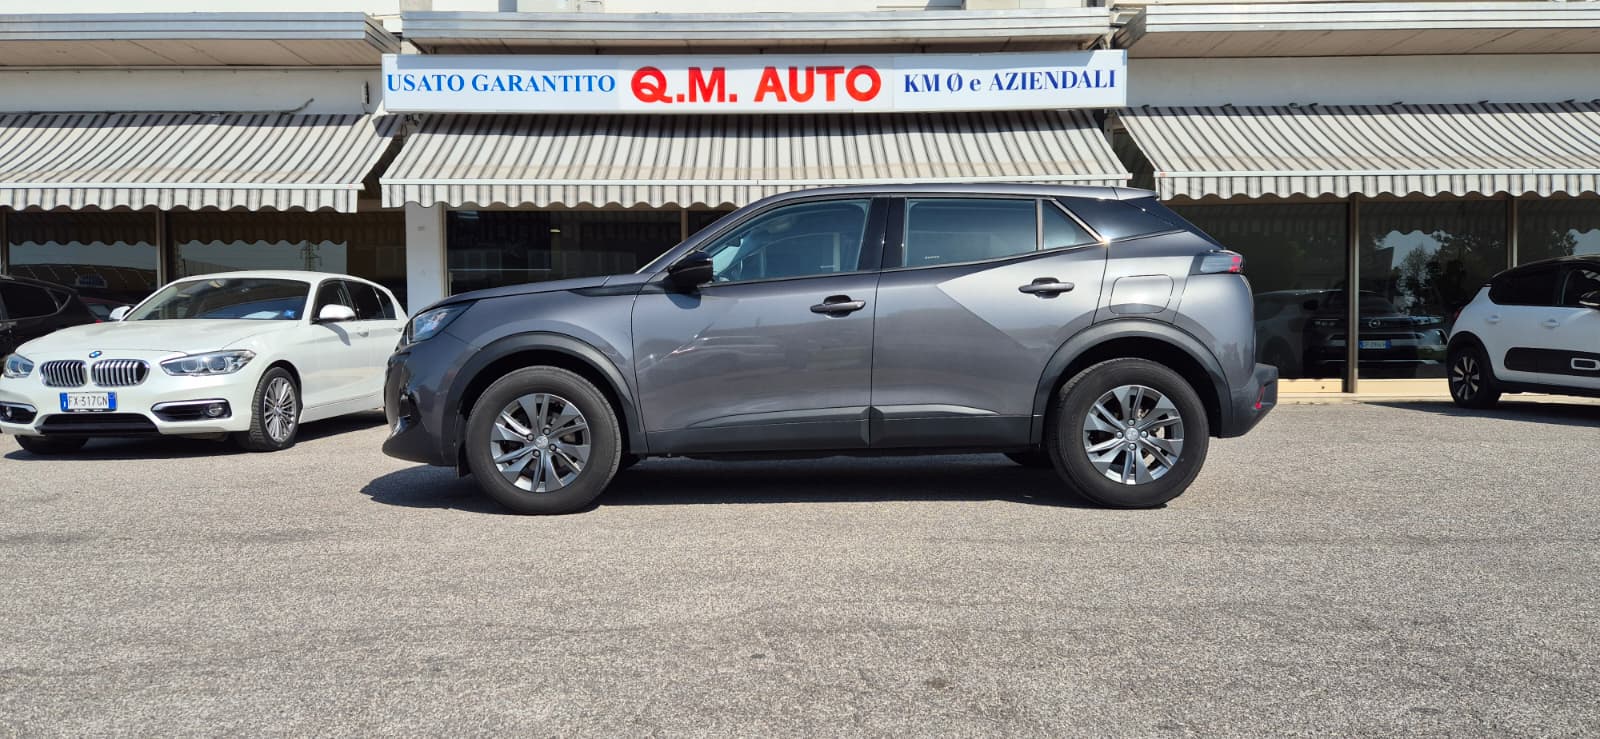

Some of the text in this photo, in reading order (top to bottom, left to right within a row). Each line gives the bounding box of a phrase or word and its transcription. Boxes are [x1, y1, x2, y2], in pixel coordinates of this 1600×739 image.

[387, 74, 616, 92] USATO GARANTITO
[631, 64, 882, 104] Q.M. AUTO
[904, 73, 939, 93] KM
[969, 78, 982, 92] e
[989, 69, 1116, 91] AZIENDALI
